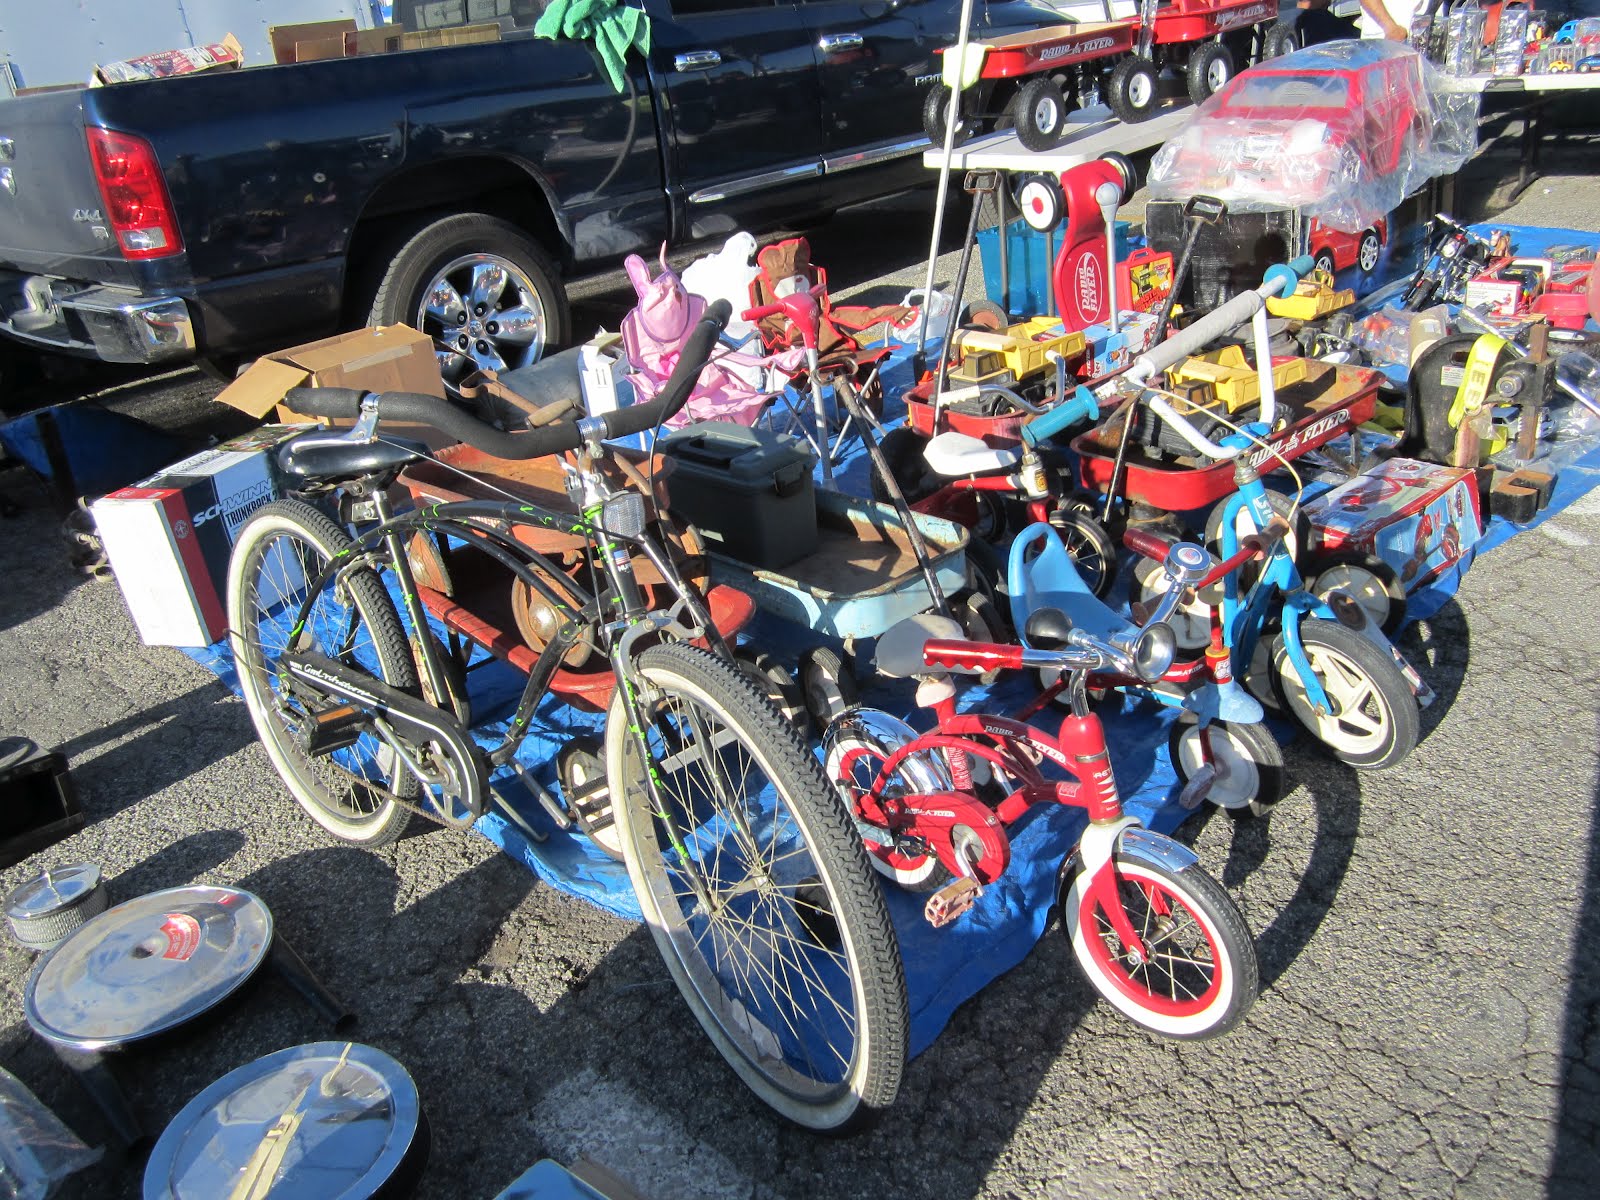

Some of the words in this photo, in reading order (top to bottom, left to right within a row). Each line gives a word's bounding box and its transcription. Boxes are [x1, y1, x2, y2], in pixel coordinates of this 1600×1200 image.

[1082, 37, 1115, 51] FLYER
[1078, 267, 1092, 311] RADIO
[1088, 267, 1098, 312] FLYER
[1302, 409, 1350, 443] FLYER
[193, 478, 273, 528] SCHWINN
[1031, 739, 1067, 764] FLYER
